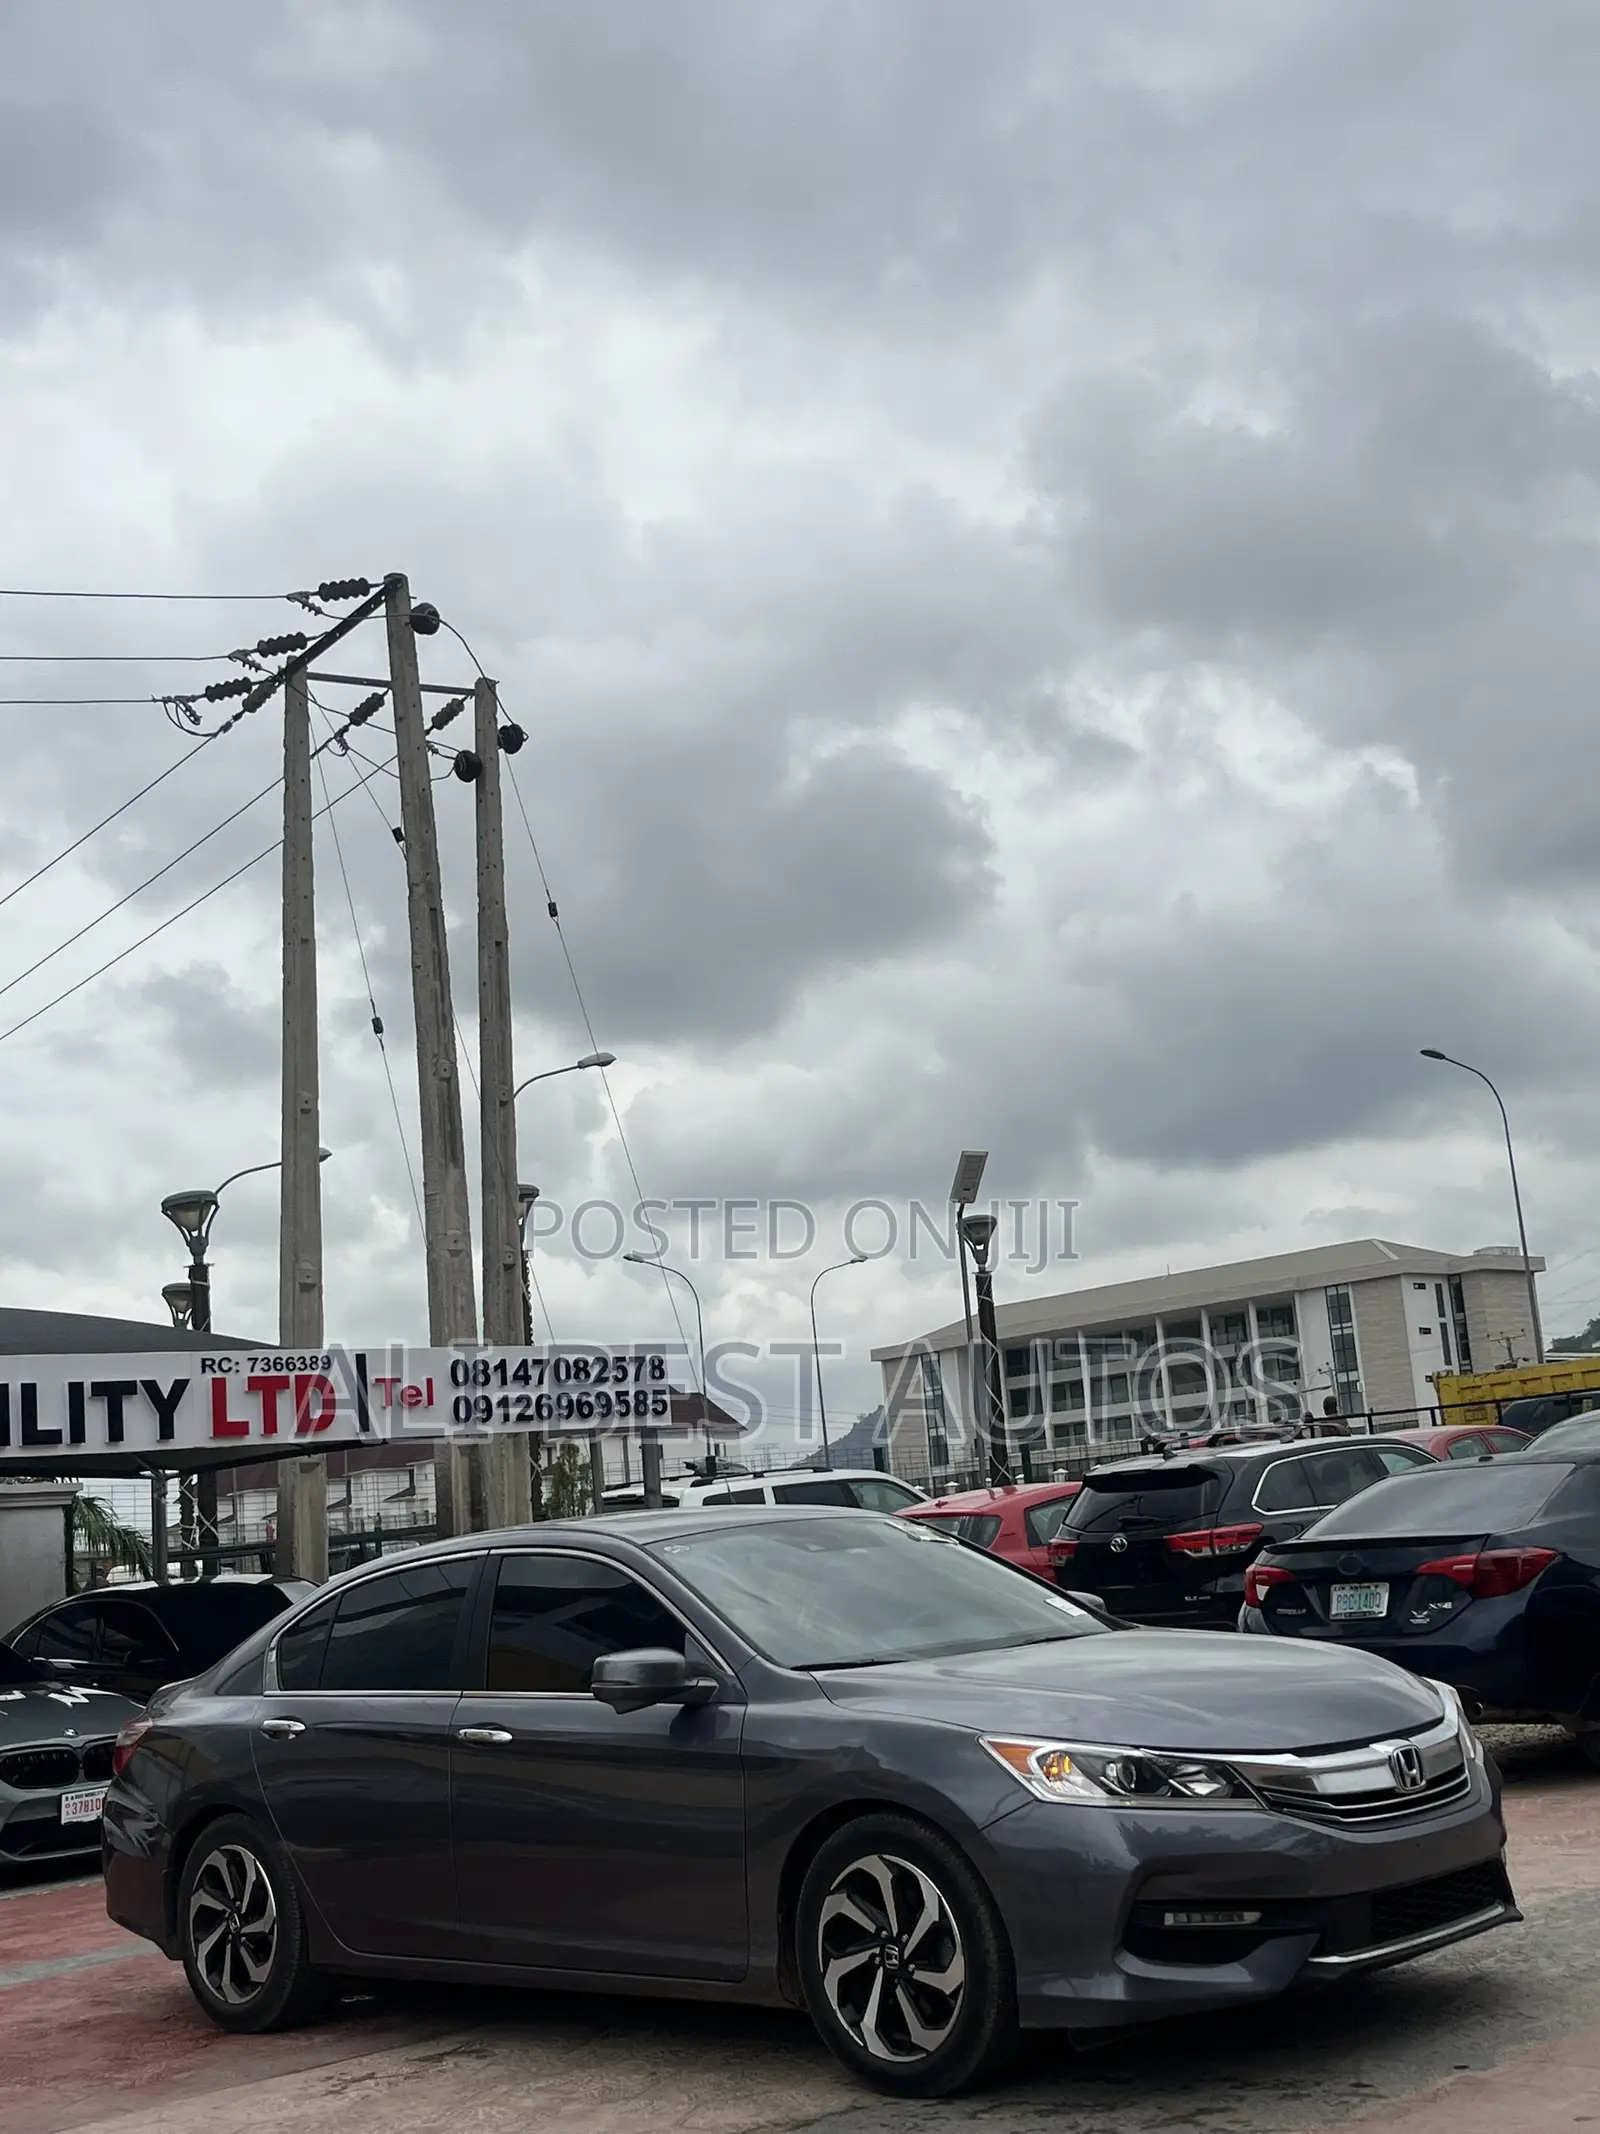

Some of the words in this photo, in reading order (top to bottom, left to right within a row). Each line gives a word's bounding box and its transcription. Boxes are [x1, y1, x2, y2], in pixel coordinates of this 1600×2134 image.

[200, 1357, 240, 1374] RC:
[247, 1355, 332, 1373] 7366389
[450, 1354, 666, 1388] 08147082578
[211, 1374, 337, 1438] LTD
[374, 1376, 434, 1409] Tel
[452, 1389, 669, 1424] 09126969585
